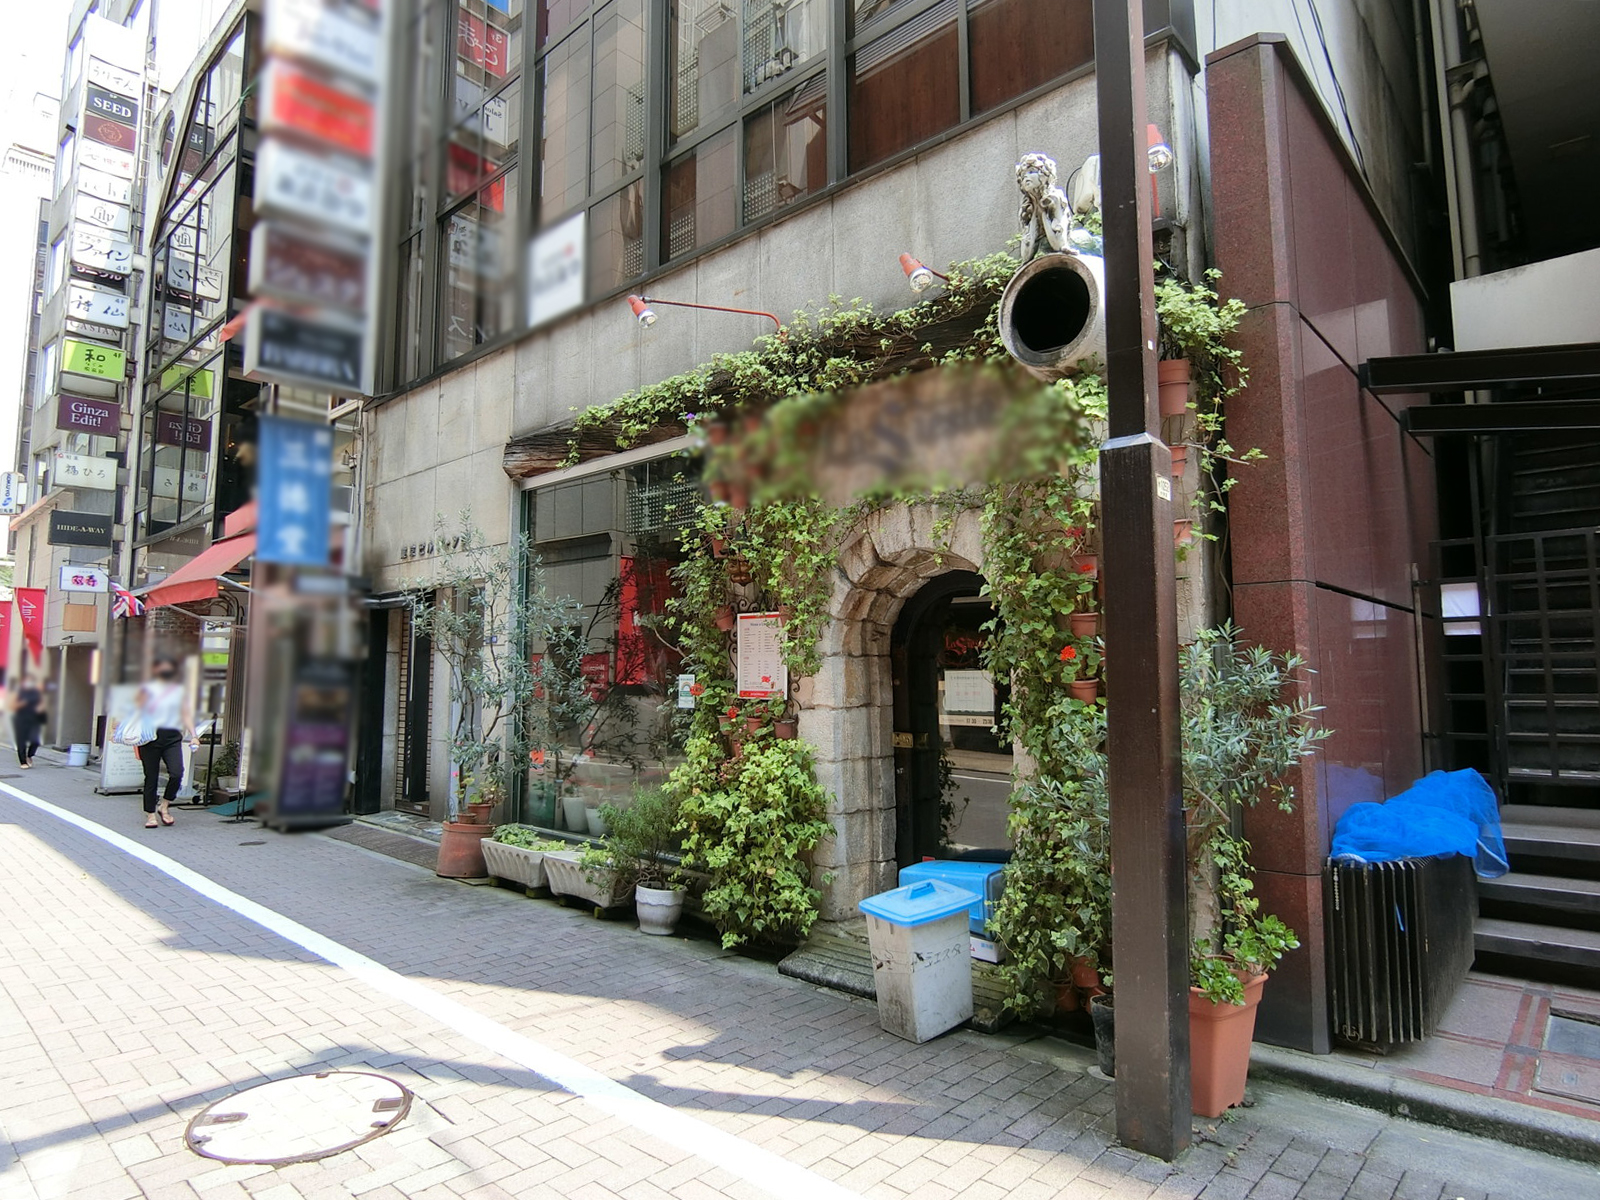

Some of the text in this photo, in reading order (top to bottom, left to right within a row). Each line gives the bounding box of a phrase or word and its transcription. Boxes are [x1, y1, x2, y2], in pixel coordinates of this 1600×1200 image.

[93, 97, 132, 118] SEED
[85, 348, 106, 362] 和
[71, 402, 110, 417] Ginza
[71, 412, 102, 427] Edit!
